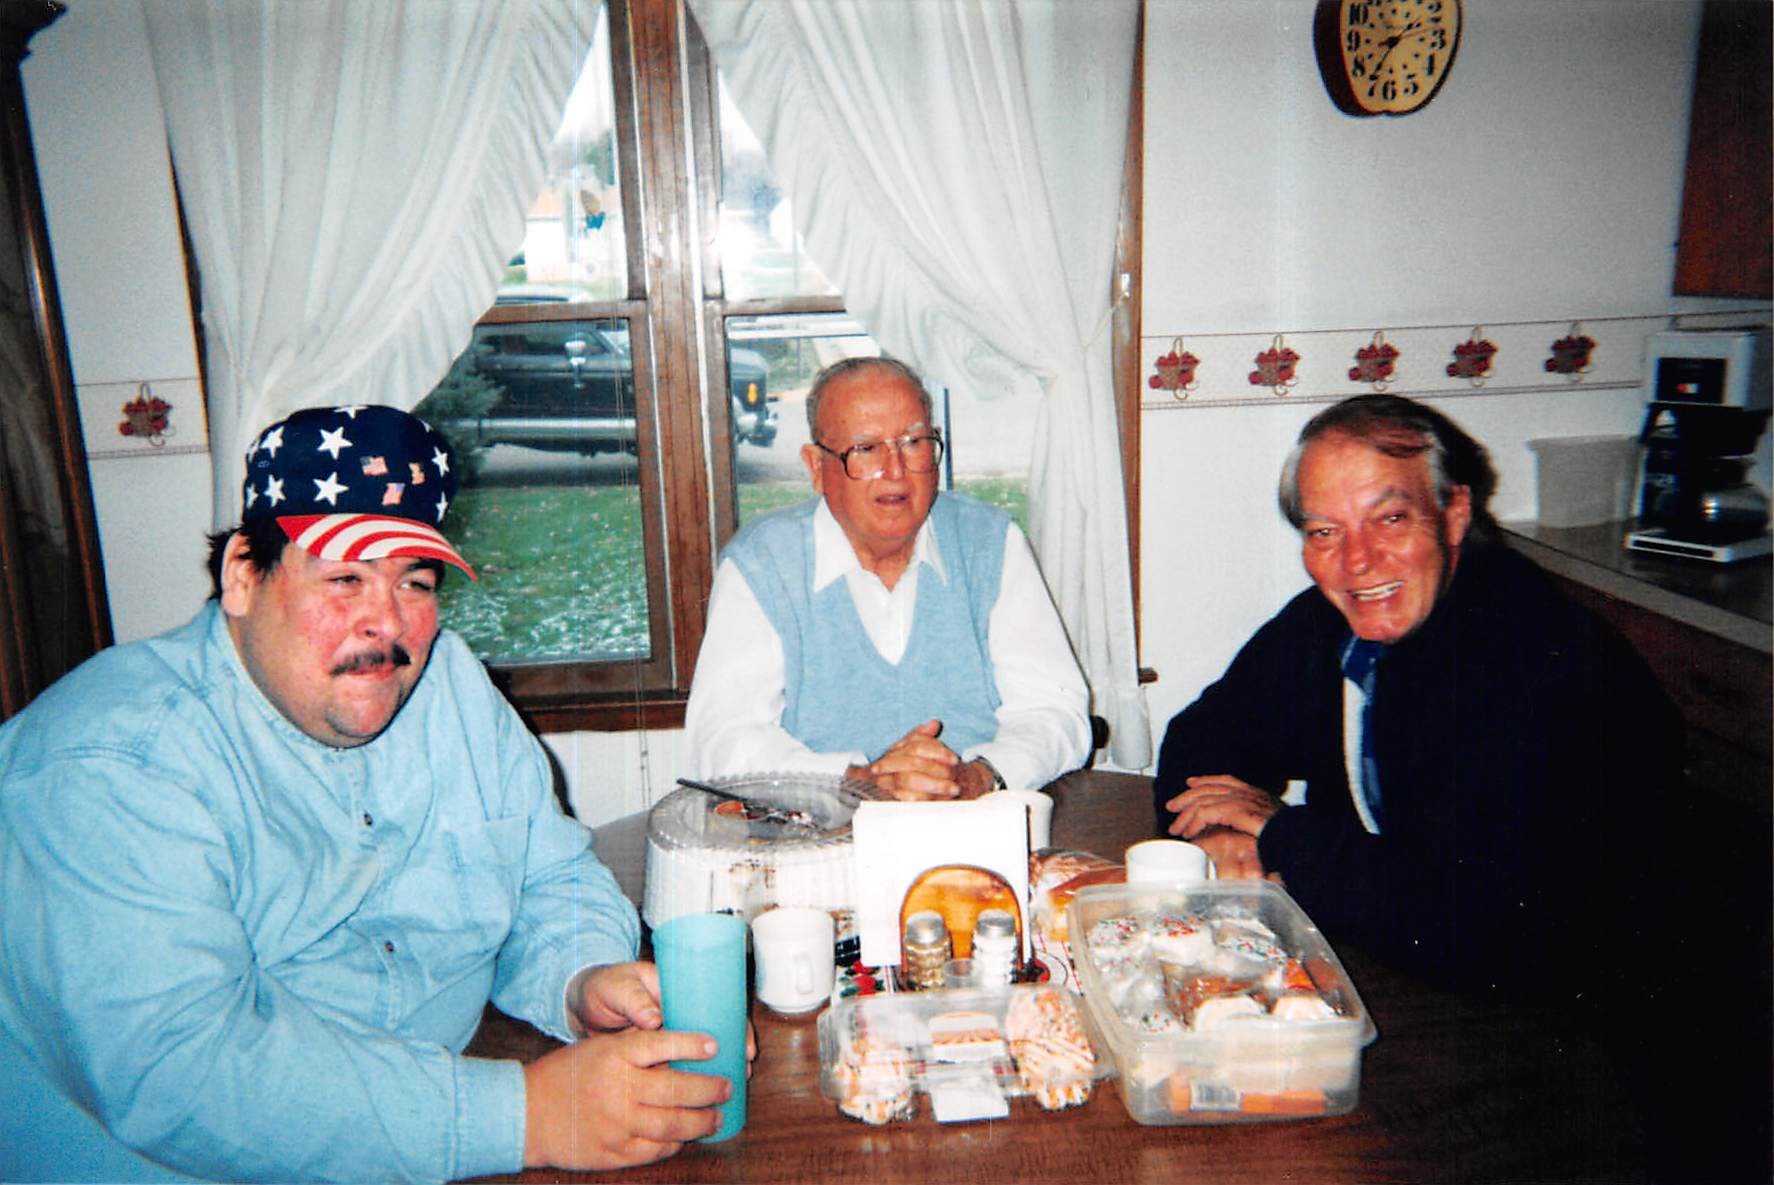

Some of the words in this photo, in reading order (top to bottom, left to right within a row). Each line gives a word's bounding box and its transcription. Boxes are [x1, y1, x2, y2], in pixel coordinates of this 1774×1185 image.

[1348, 2, 1368, 25] 10
[1428, 0, 1442, 23] 2
[1347, 29, 1360, 52] 9
[1430, 28, 1446, 50] 3
[1351, 53, 1366, 77] 8
[1368, 74, 1381, 97] 7
[1382, 79, 1397, 100] 6
[1403, 73, 1419, 95] 5
